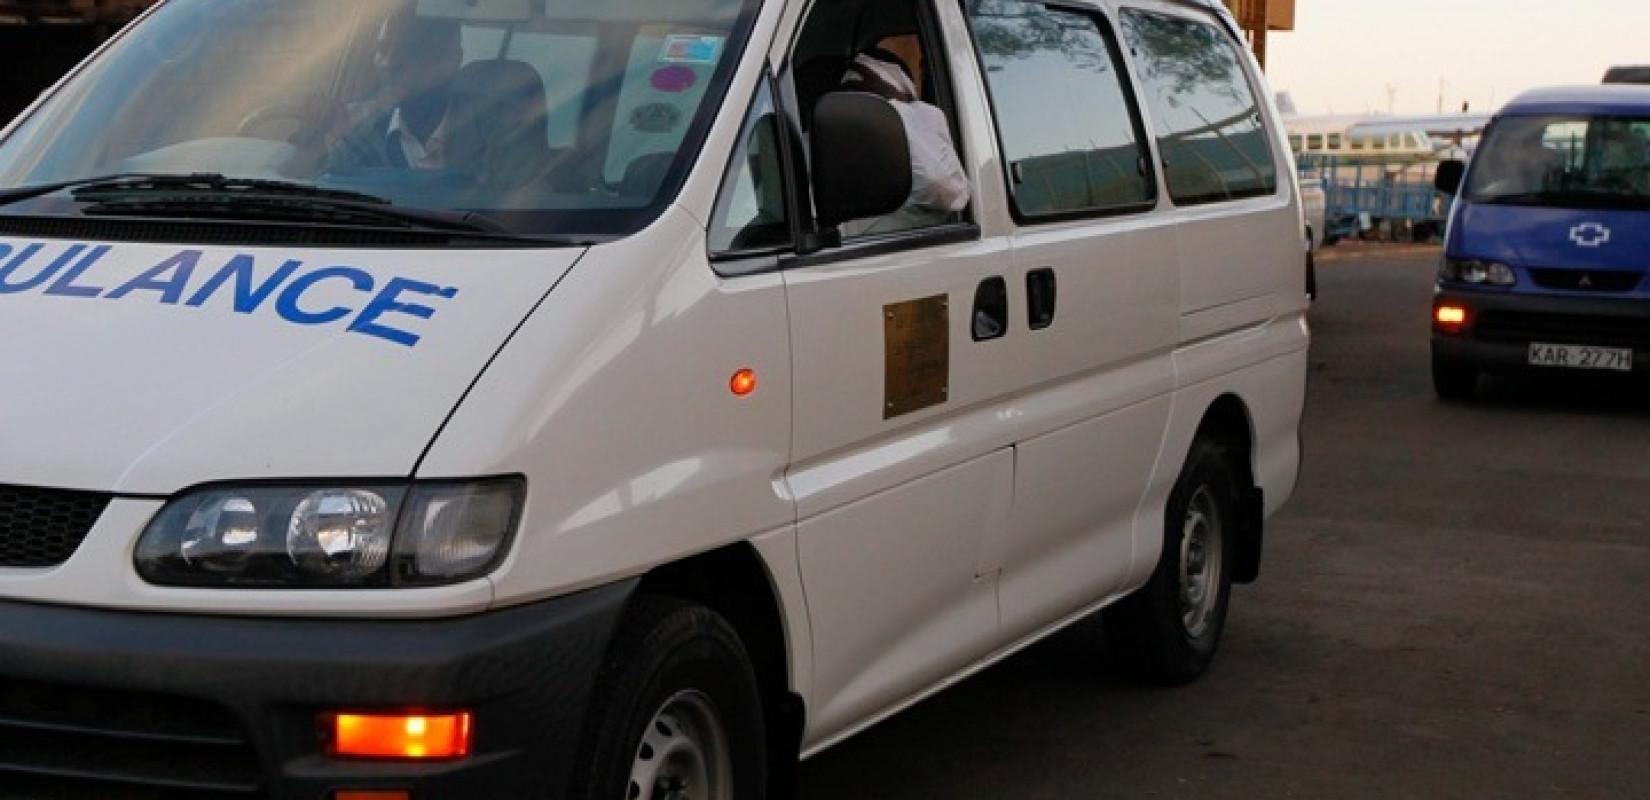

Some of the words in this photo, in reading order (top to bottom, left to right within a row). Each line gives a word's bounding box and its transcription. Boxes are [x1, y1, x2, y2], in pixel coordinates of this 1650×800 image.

[0, 243, 458, 347] ULANCE
[1531, 345, 1569, 363] KAR
[1579, 348, 1631, 368] 277H
